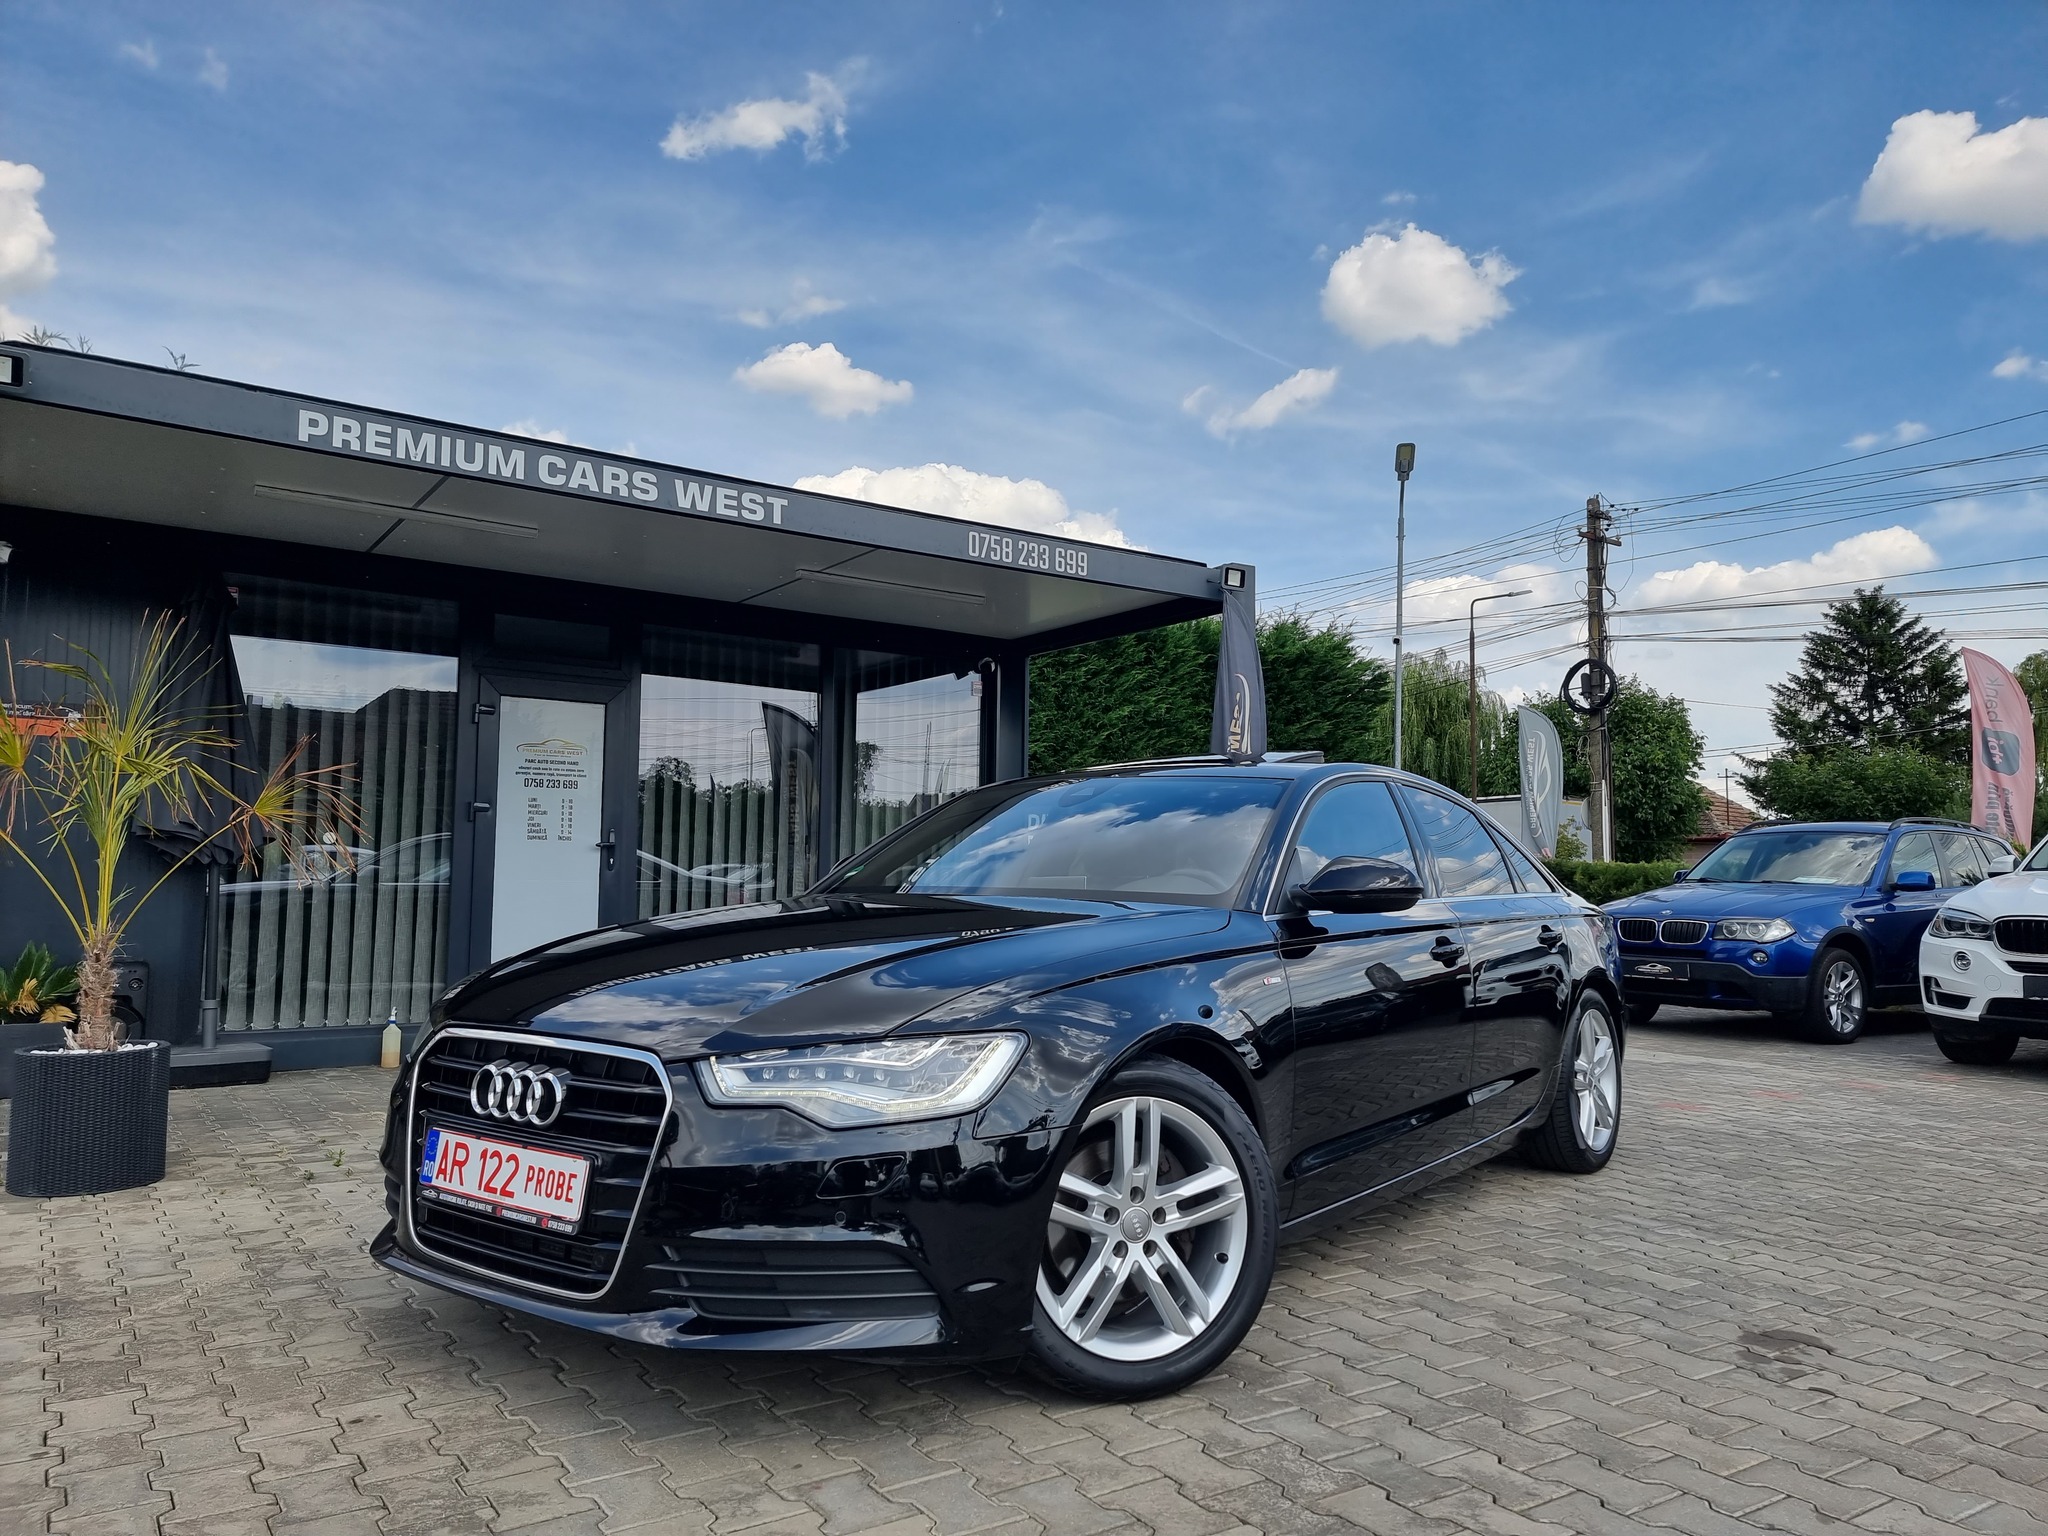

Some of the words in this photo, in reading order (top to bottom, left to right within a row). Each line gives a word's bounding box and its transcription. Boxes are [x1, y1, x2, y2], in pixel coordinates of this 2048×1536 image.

[298, 409, 526, 480] PREMIUM
[538, 454, 658, 502] CARS
[674, 478, 789, 525] WEST
[968, 531, 1013, 563] 0758
[1018, 540, 1050, 569] 233
[1055, 547, 1088, 576] 699
[523, 778, 544, 788] 0758
[546, 779, 560, 789] 233
[563, 780, 578, 789] 699
[423, 1159, 435, 1178] RO
[435, 1139, 471, 1187] AR
[477, 1147, 520, 1199] 122
[523, 1164, 578, 1204] PROBE
